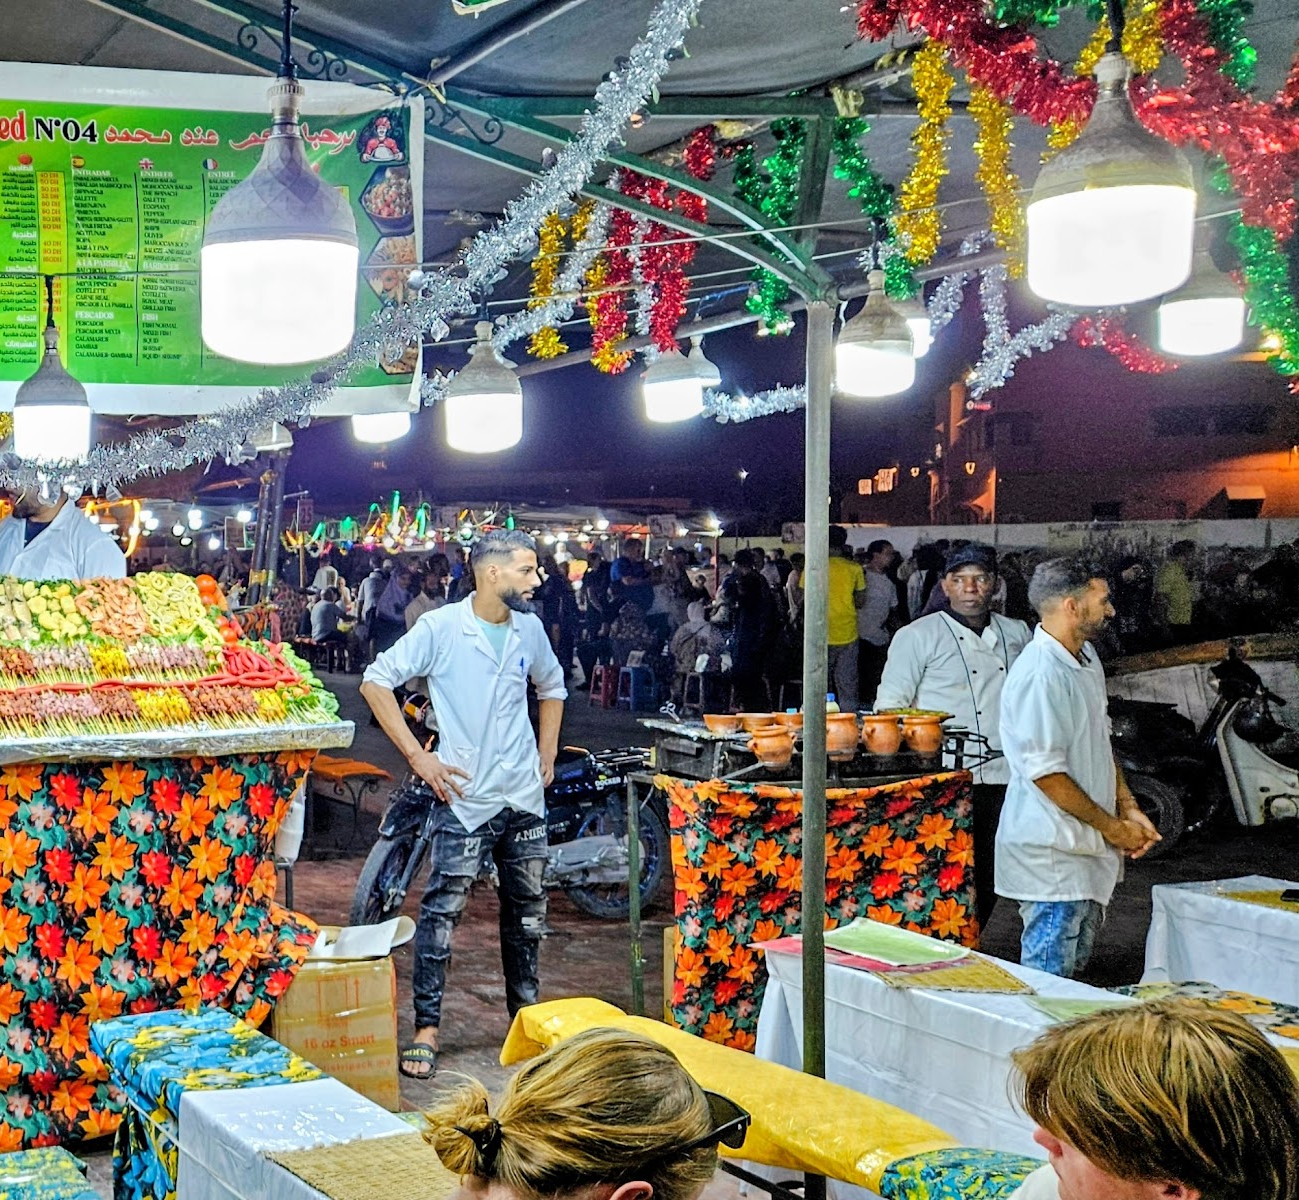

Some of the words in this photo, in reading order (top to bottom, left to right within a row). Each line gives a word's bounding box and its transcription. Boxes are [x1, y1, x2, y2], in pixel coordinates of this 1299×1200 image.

[104, 125, 172, 145] محمد
[179, 125, 220, 147] عند
[340, 1034, 375, 1047] Smart
